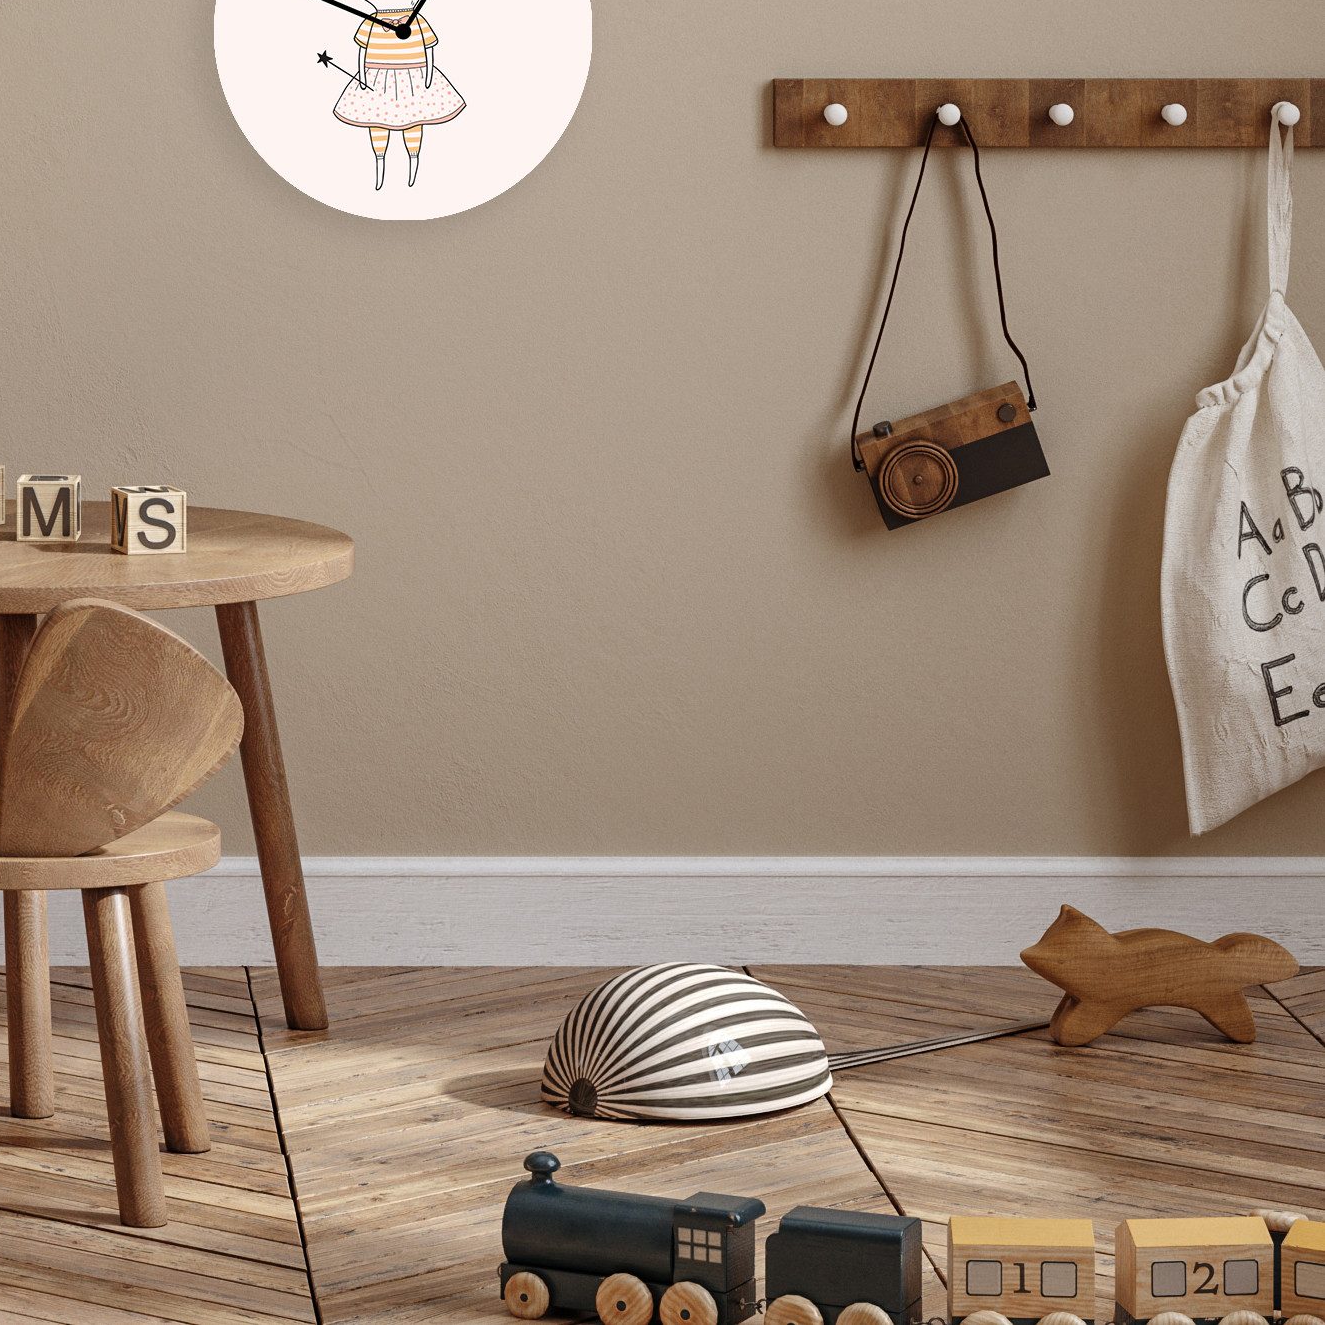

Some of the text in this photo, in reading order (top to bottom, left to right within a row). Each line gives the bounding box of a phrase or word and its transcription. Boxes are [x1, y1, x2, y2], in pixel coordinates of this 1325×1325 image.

[22, 486, 71, 537] M
[137, 497, 177, 550] S
[1013, 1262, 1032, 1294] 1
[1192, 1261, 1219, 1295] 2
